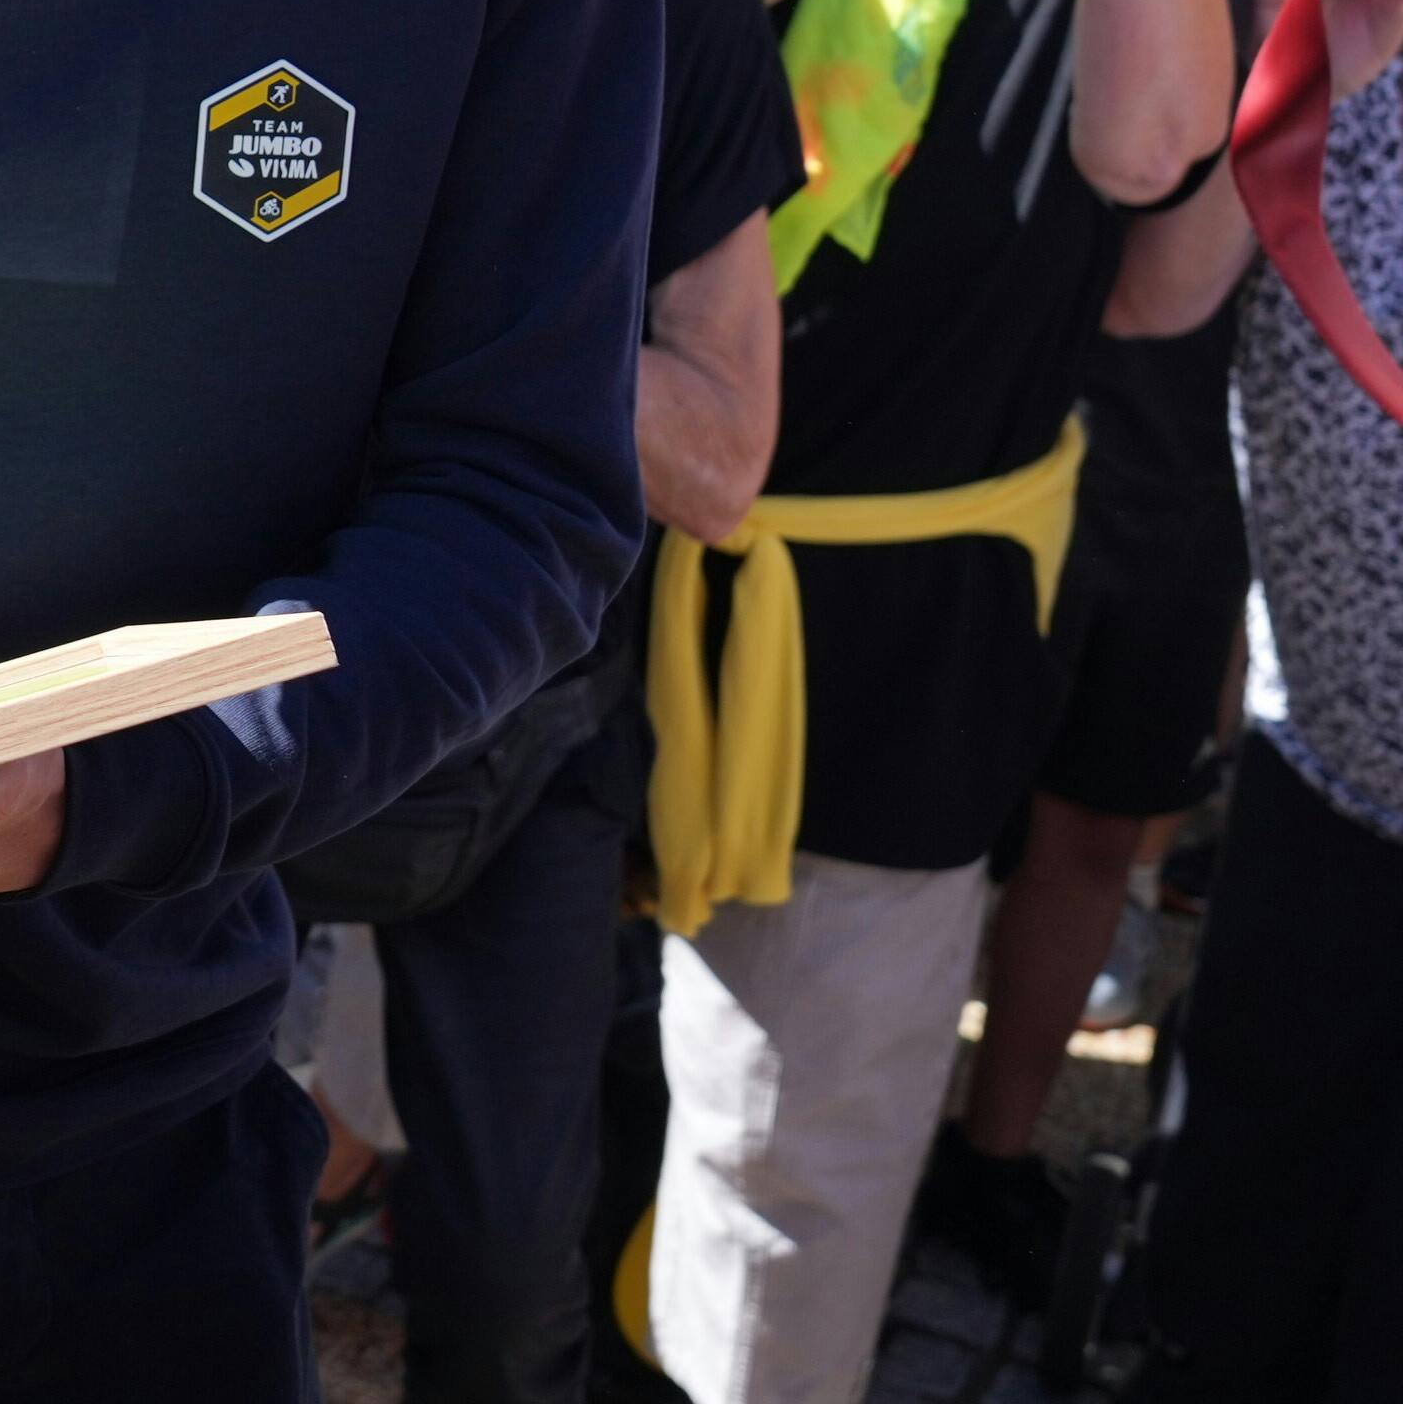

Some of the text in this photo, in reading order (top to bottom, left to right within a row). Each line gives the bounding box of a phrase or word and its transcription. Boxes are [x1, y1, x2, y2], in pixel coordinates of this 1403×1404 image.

[252, 119, 304, 134] TEAM
[228, 134, 323, 157] JUMBO
[259, 158, 319, 180] VISMA
